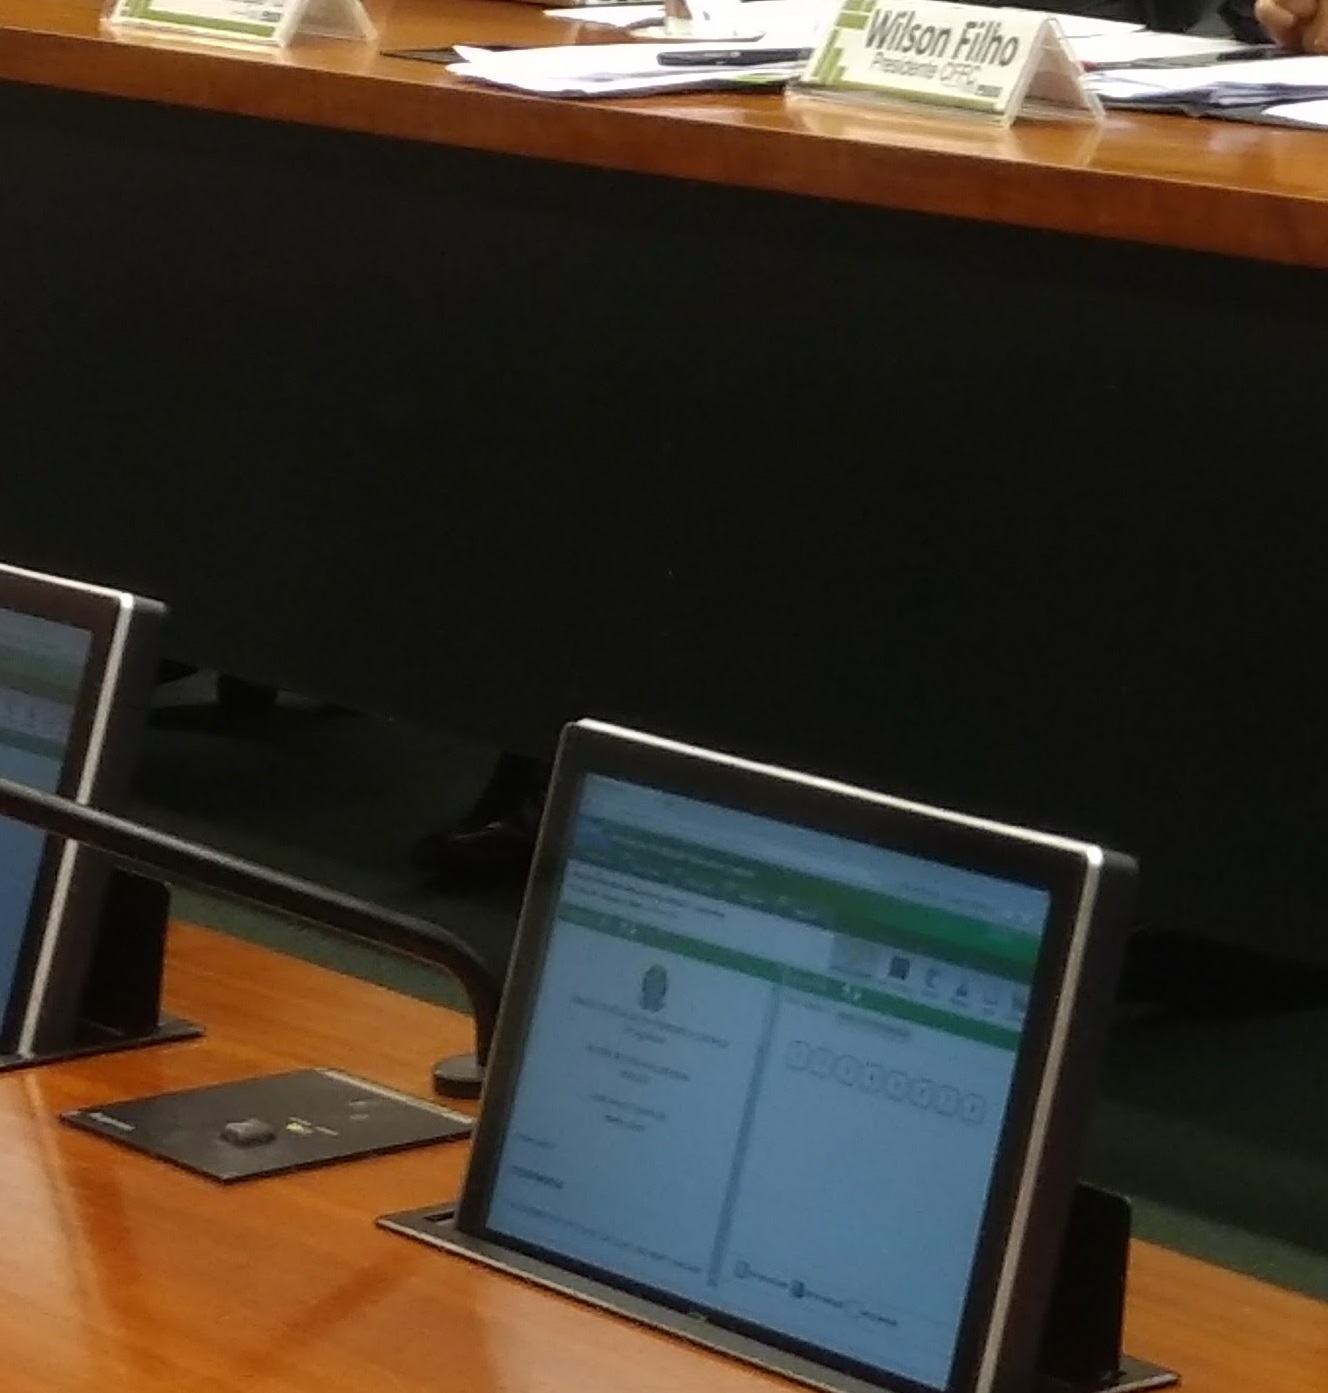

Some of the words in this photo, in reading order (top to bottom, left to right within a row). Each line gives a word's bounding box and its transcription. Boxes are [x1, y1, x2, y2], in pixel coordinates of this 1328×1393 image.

[865, 10, 950, 58] Wilson
[954, 20, 1020, 67] Filho
[871, 52, 938, 79] Presidente
